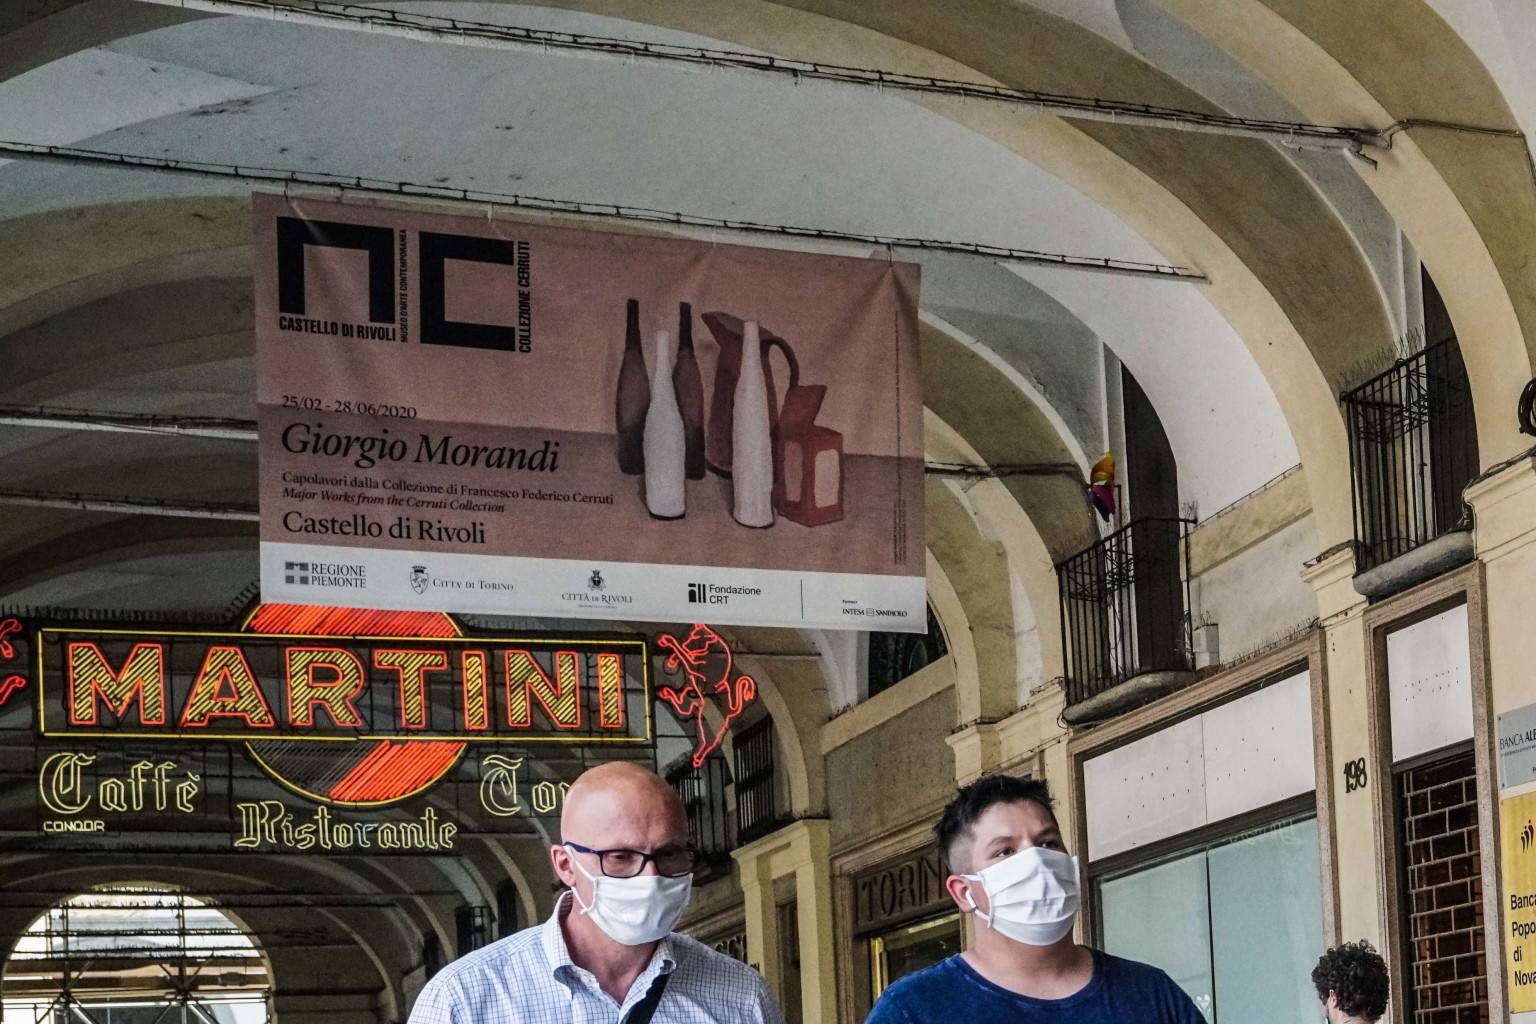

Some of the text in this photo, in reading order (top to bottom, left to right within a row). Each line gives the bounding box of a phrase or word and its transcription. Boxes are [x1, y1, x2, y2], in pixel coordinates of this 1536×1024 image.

[518, 241, 532, 352] COLLEZIONE CERRUTI
[279, 316, 396, 342] CASTELLO DI RIVOLI
[282, 395, 322, 411] 25/02
[335, 400, 417, 420] 28/06/2020
[282, 423, 560, 473] Giorgio Morandi
[282, 471, 614, 505] Capolavori dalla Collezione di Francesco Federico Cerruti
[282, 487, 505, 513] Major Works from the Cerruti Collection
[282, 511, 487, 545] Castello di Rivoli
[311, 563, 366, 577] REGIONE
[311, 575, 366, 589] PIEMONTE
[709, 584, 761, 596] Fondazione
[709, 595, 730, 605] CRT
[67, 642, 622, 731] MARTINI
[1499, 733, 1523, 750] BANCA
[39, 752, 200, 815] Caffè
[1343, 756, 1367, 794] 198
[233, 800, 458, 850] Ristorante
[861, 855, 950, 921] TORIN
[1513, 945, 1523, 963] di
